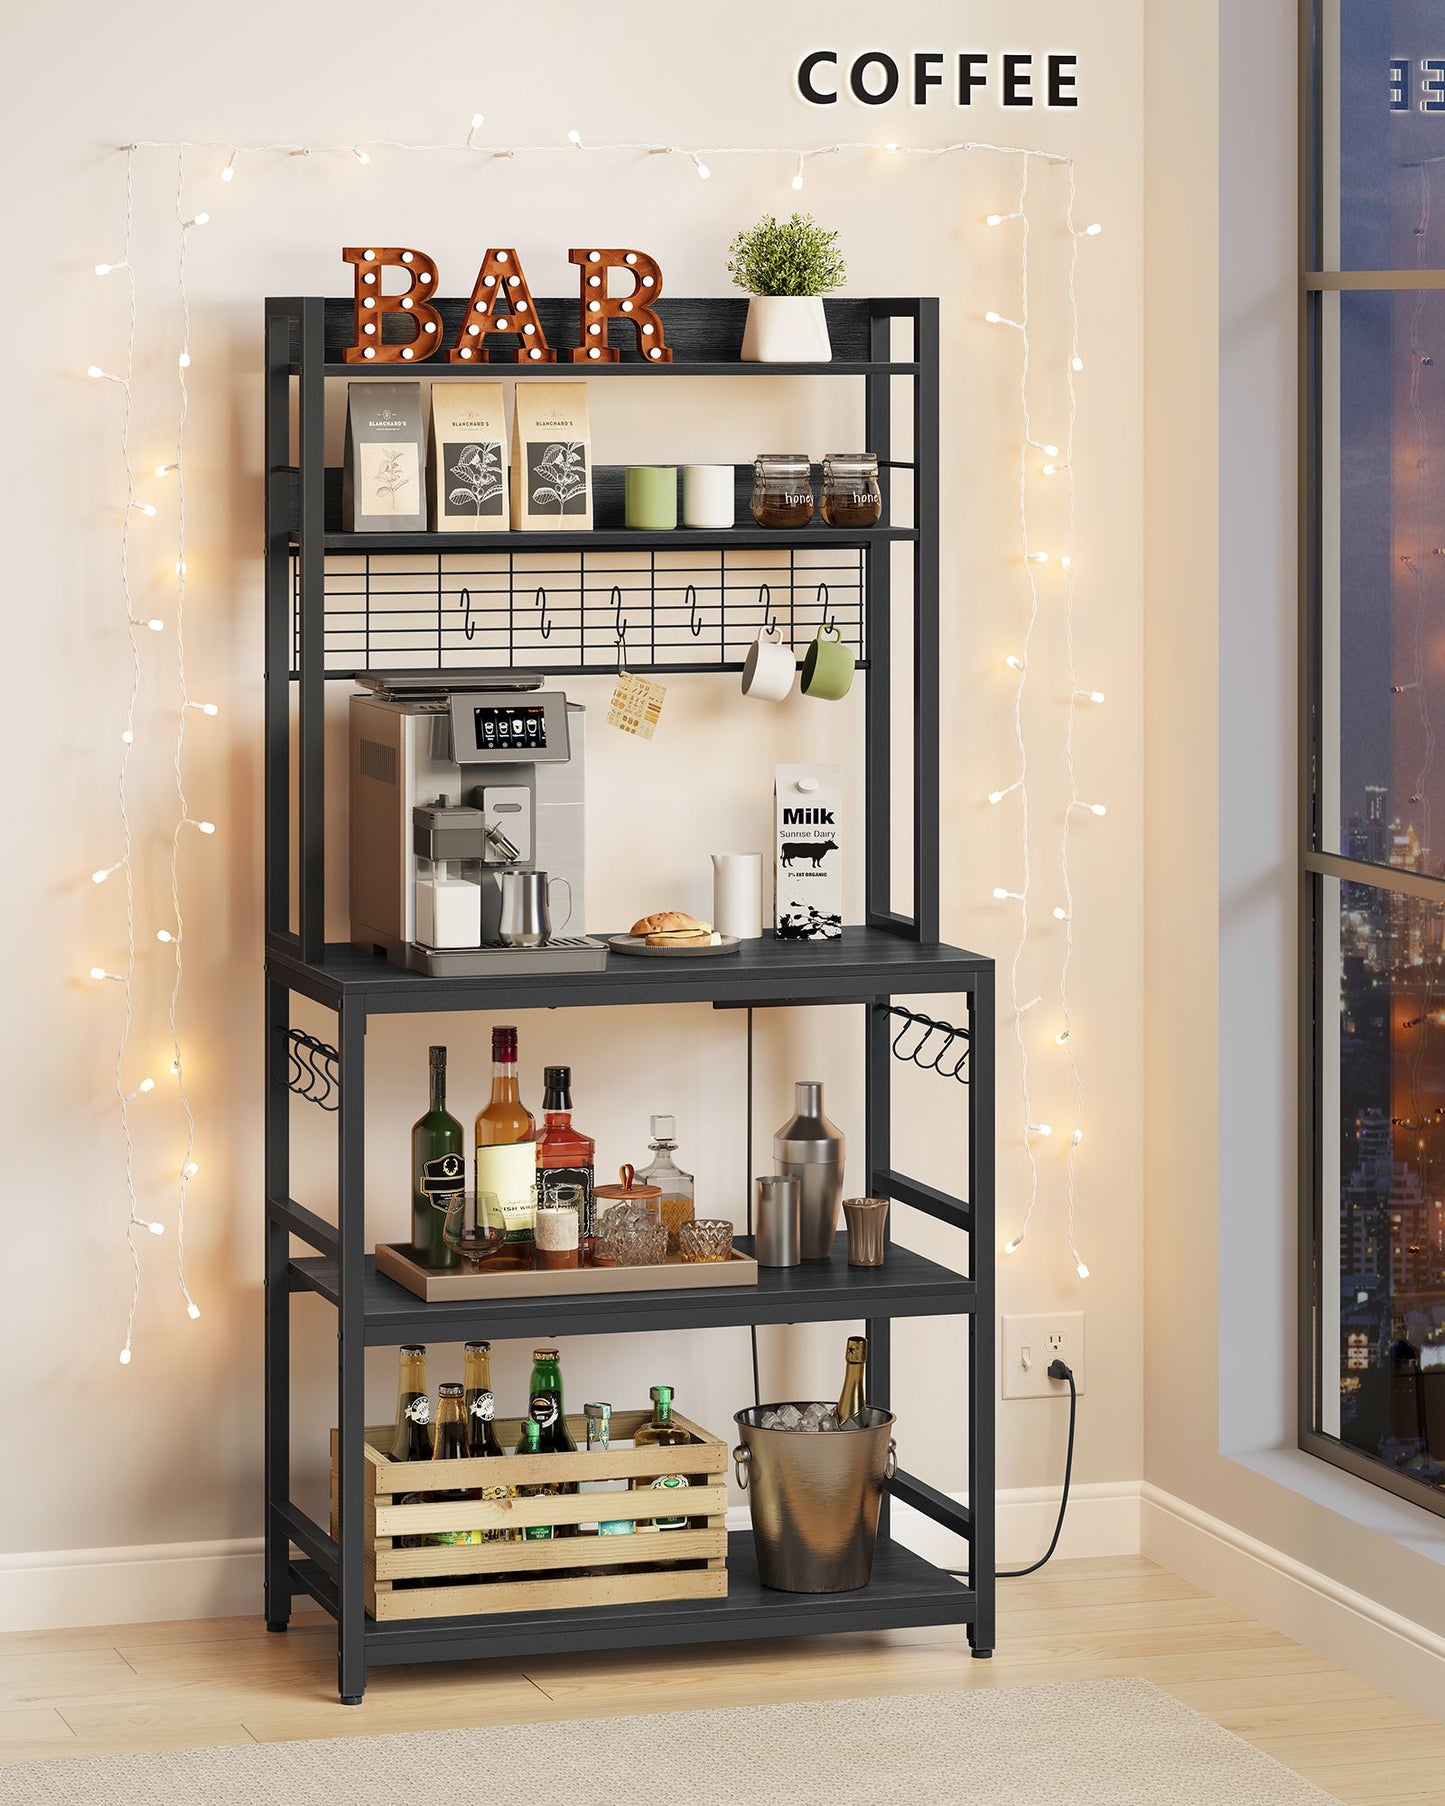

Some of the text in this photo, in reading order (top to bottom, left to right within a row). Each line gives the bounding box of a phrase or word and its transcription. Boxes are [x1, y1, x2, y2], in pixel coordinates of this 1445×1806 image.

[797, 50, 1079, 107] COFFEE
[341, 246, 674, 364] BAR
[785, 491, 814, 507] honey
[783, 807, 835, 825] Milk
[779, 830, 836, 839] Sunrise Dairy
